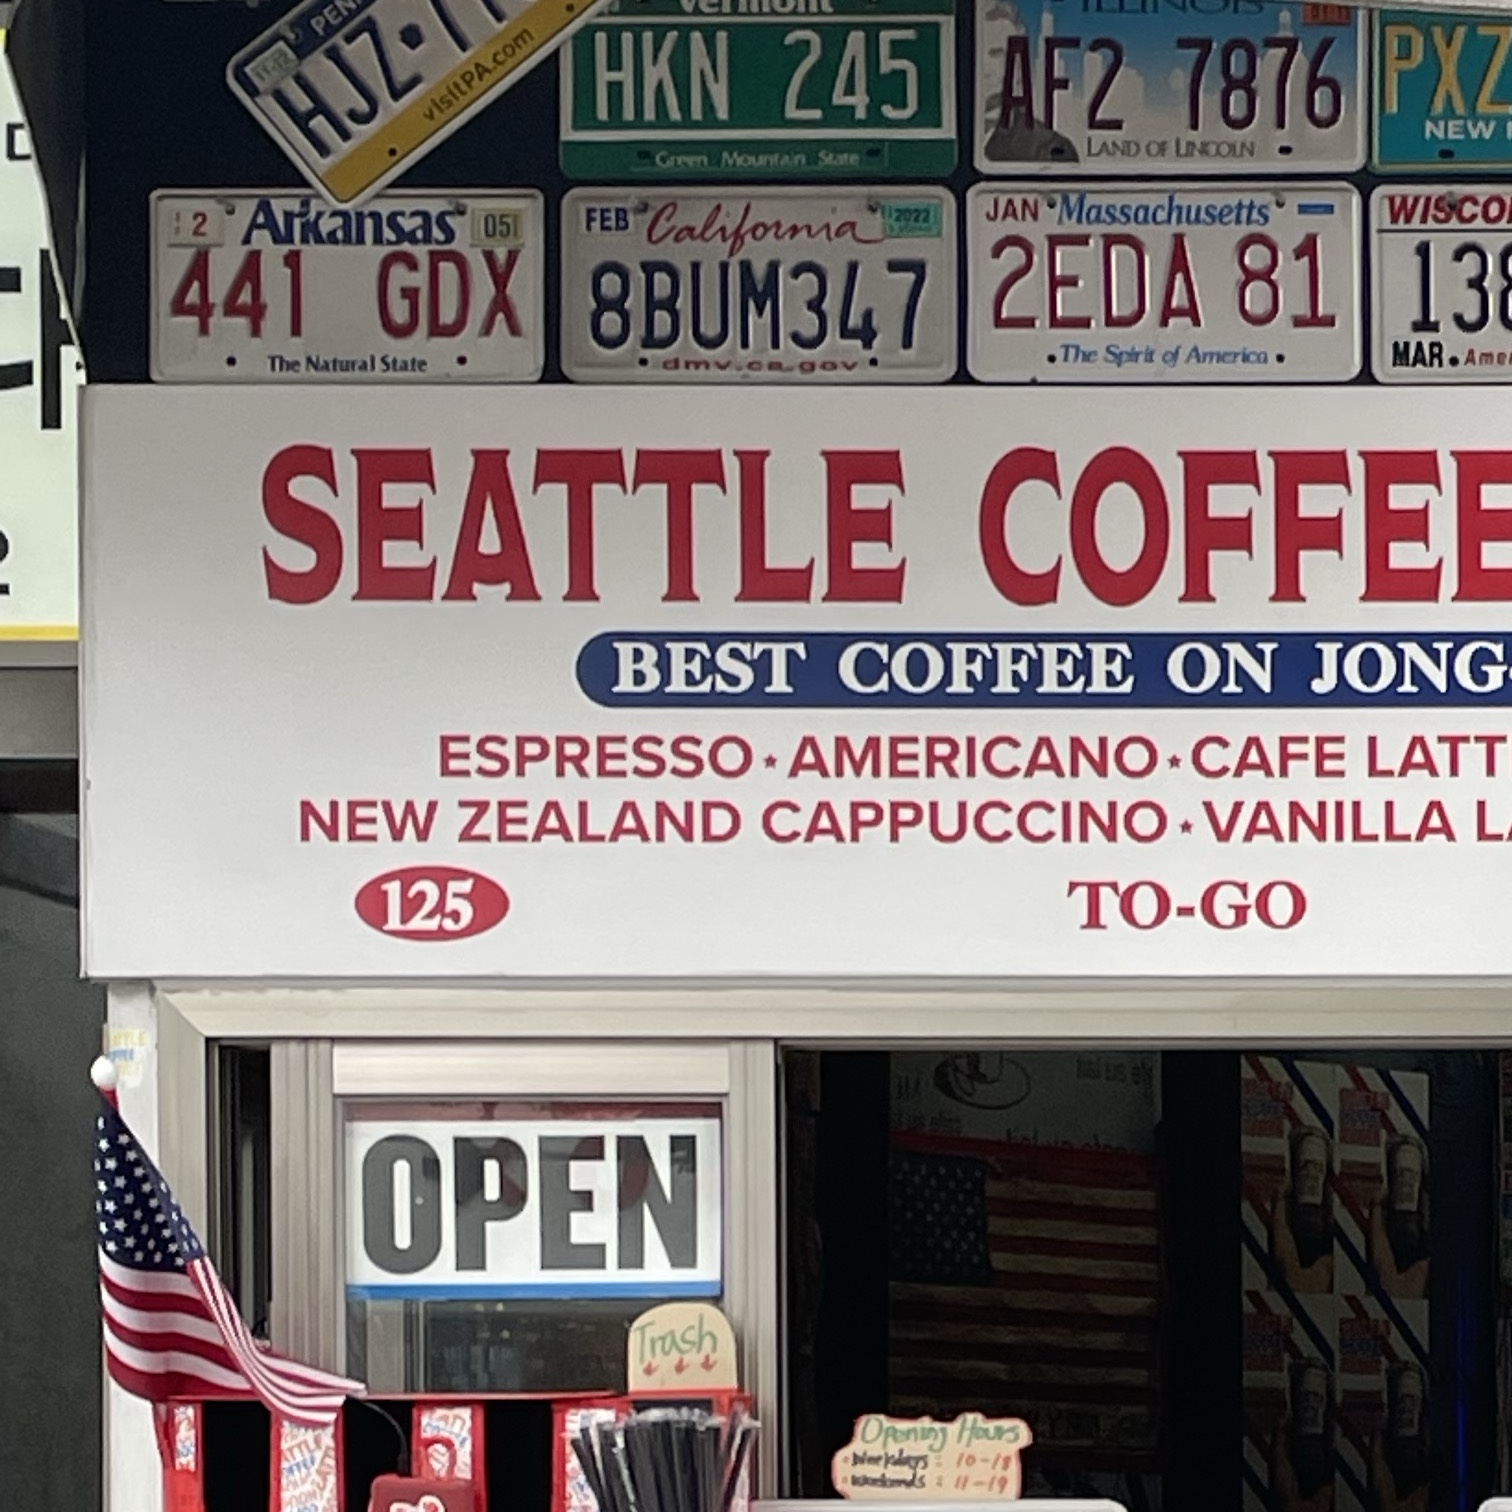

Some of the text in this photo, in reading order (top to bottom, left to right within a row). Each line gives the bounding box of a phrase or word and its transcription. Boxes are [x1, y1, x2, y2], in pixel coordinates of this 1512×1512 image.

[422, 26, 536, 122] visitPA.com
[594, 29, 920, 122] HKN 245
[1000, 35, 1343, 131] AF2 7876
[1086, 136, 1256, 159] LAND OF LINCOLN
[1425, 118, 1495, 141] NEW
[654, 150, 861, 168] Green Mountain State
[191, 212, 208, 237] 2
[241, 196, 457, 246] Arkansas
[585, 206, 630, 232] FEB
[646, 201, 884, 258] California
[892, 206, 931, 224] 2022
[985, 198, 1040, 223] JAN
[1056, 192, 1271, 227] Massachusetts
[170, 249, 303, 339] 441
[377, 249, 523, 339] GDX
[990, 232, 1337, 330] 2EDA 81
[590, 259, 928, 352] 8BUM347
[266, 354, 428, 373] The Natural State
[662, 356, 859, 373] dmv.ca.gov
[1060, 343, 1269, 367] The Spirit of America
[1391, 340, 1445, 368] MAR
[261, 443, 907, 606] SEATTLE
[609, 641, 807, 695] BEST
[838, 640, 1135, 695] COFFEE
[1166, 640, 1280, 694] ON
[439, 734, 753, 780] ESPRESSO
[787, 734, 1158, 780] AMERICANO
[1190, 733, 1346, 780] CAFE
[298, 798, 439, 844] NEW
[457, 798, 742, 844] ZEALAND
[761, 798, 1168, 845] CAPPUCCINO
[1202, 798, 1456, 844] VANILLA
[380, 877, 475, 931] 125
[1068, 879, 1307, 931] TO-GO
[360, 1134, 698, 1275] OPEN
[633, 1314, 718, 1361] Trash
[861, 1413, 1021, 1453] Opening Hours
